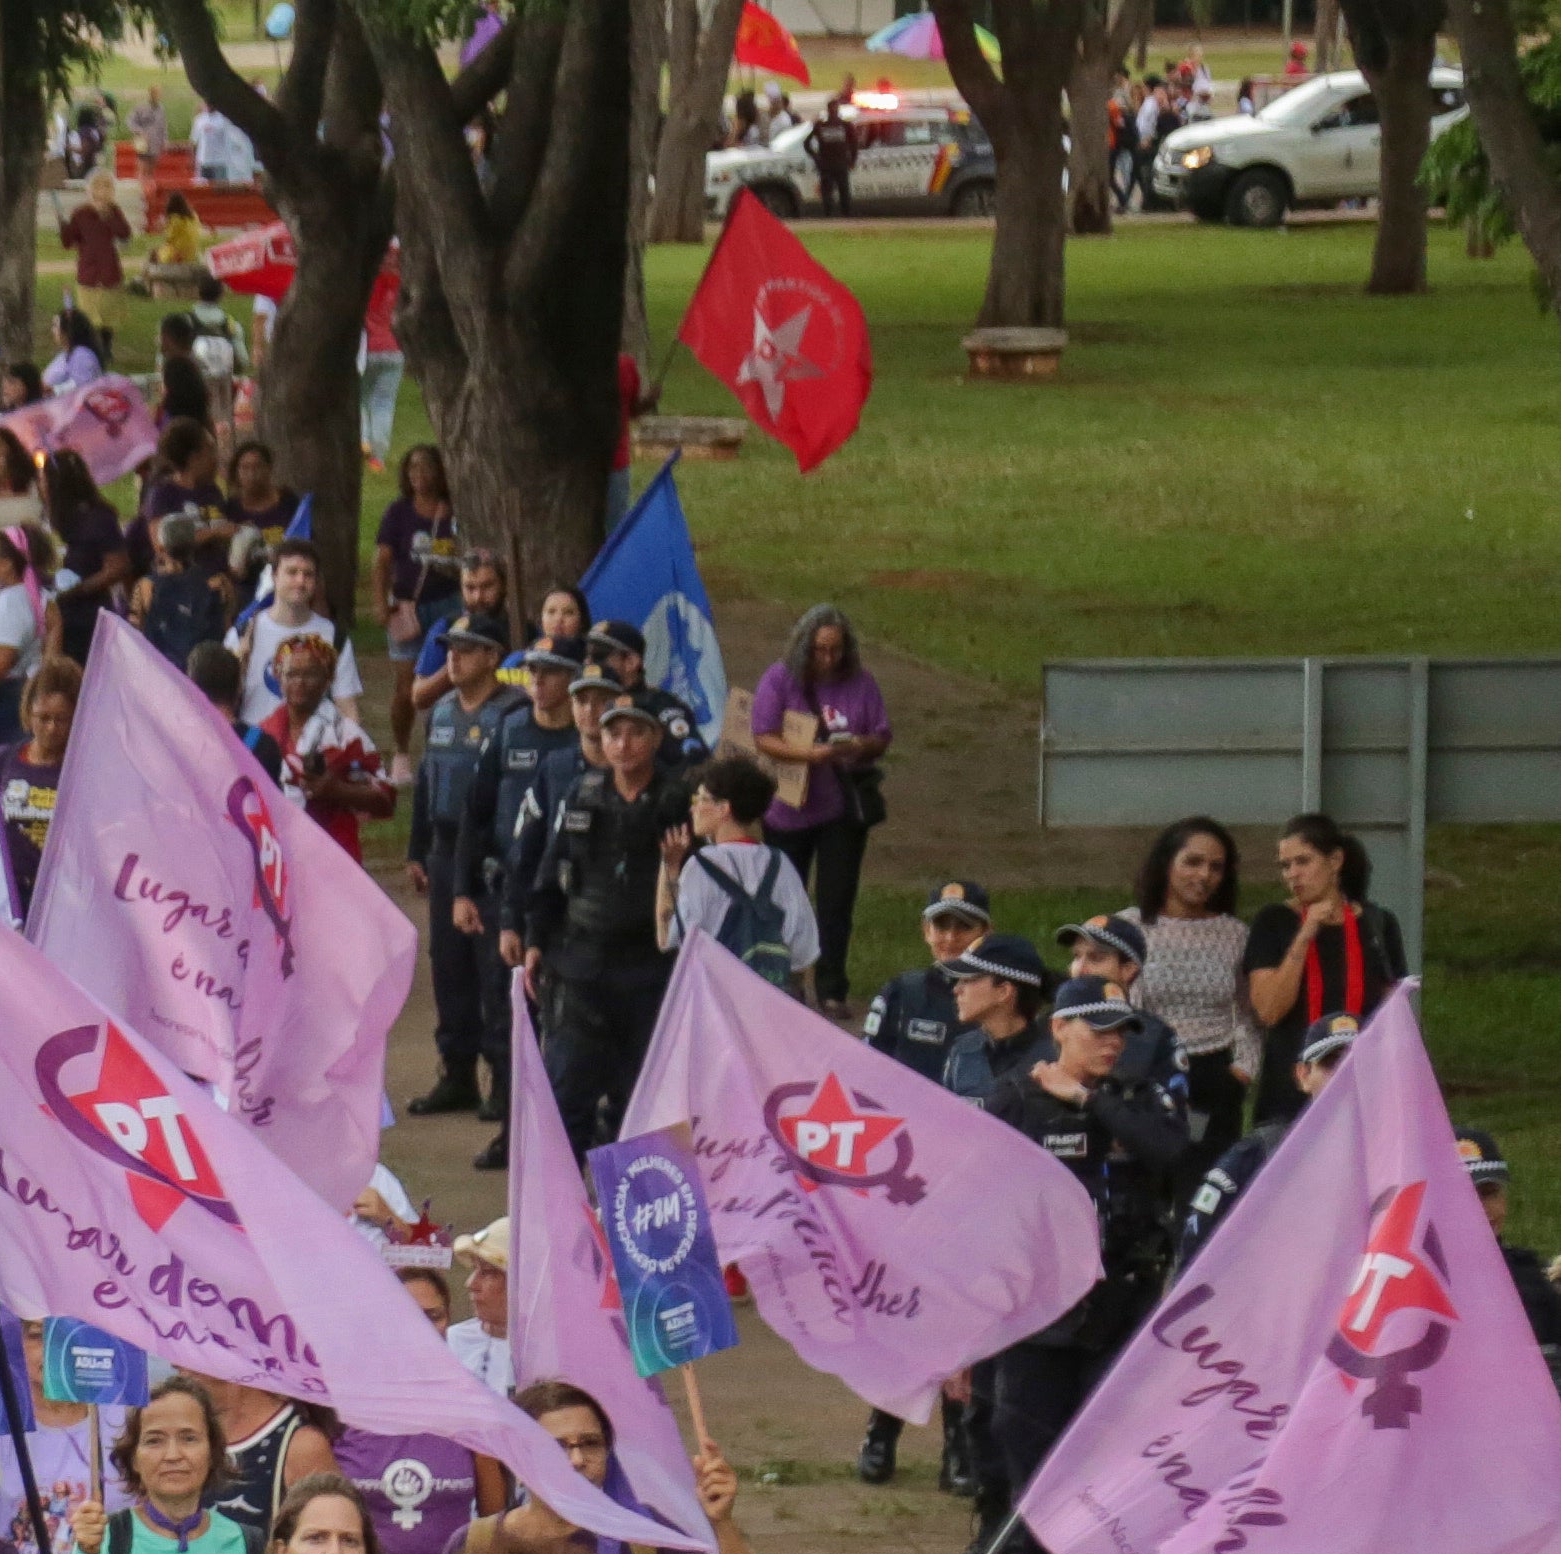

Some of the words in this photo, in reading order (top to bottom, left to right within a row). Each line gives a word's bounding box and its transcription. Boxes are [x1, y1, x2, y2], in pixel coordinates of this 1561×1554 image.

[115, 852, 234, 938] Lugar
[195, 970, 242, 1009] na
[94, 1095, 199, 1181] PT
[796, 1119, 866, 1169] PT
[632, 1191, 681, 1236] #8M
[1152, 1284, 1291, 1441] Lugar
[1156, 1452, 1212, 1521] na
